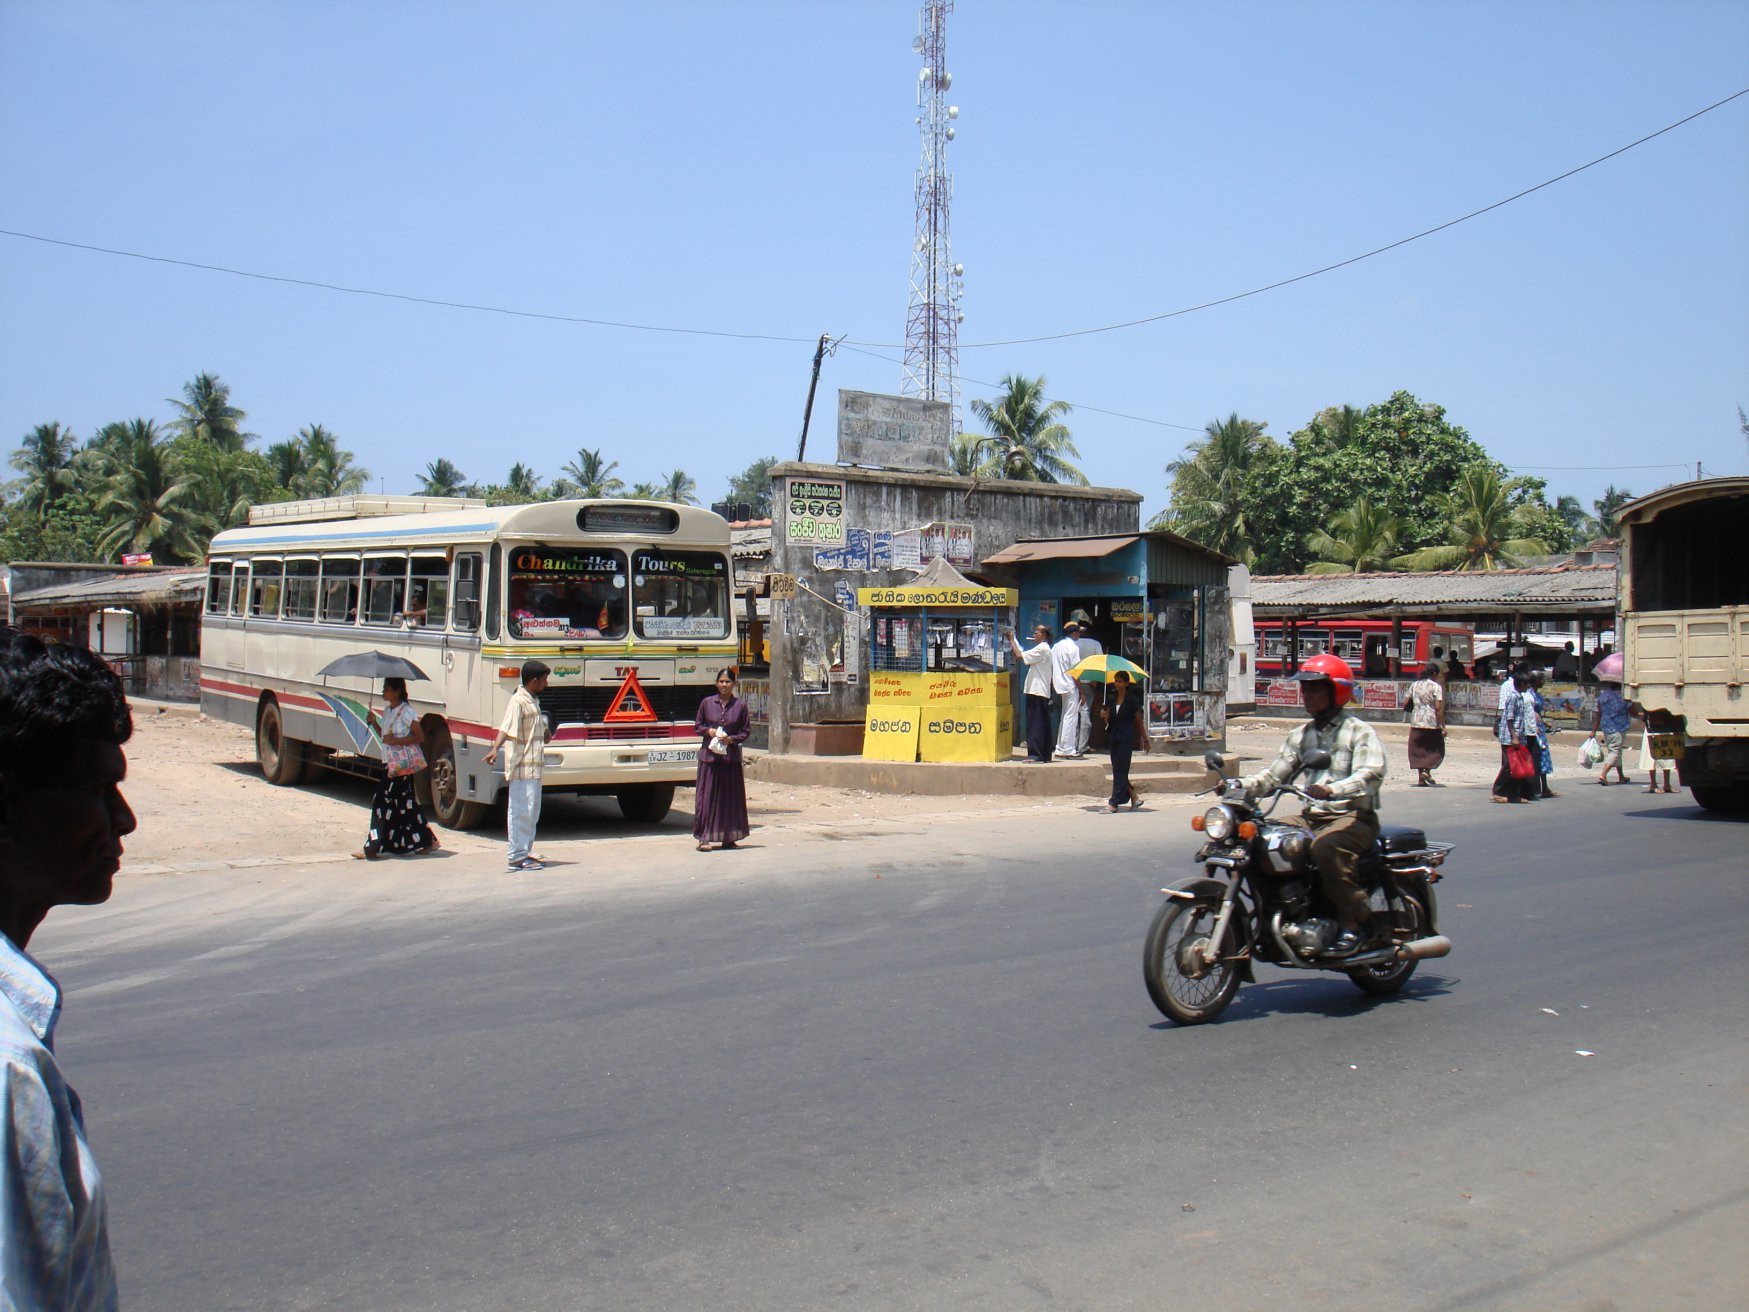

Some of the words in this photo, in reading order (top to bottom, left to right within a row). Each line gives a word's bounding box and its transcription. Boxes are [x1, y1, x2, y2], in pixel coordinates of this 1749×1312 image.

[517, 554, 618, 571] Chandrika
[638, 556, 686, 572] Tours
[871, 590, 905, 603] ජාතික
[928, 719, 982, 734] සම්පත
[656, 752, 667, 762] JZ
[676, 751, 696, 761] 1987
